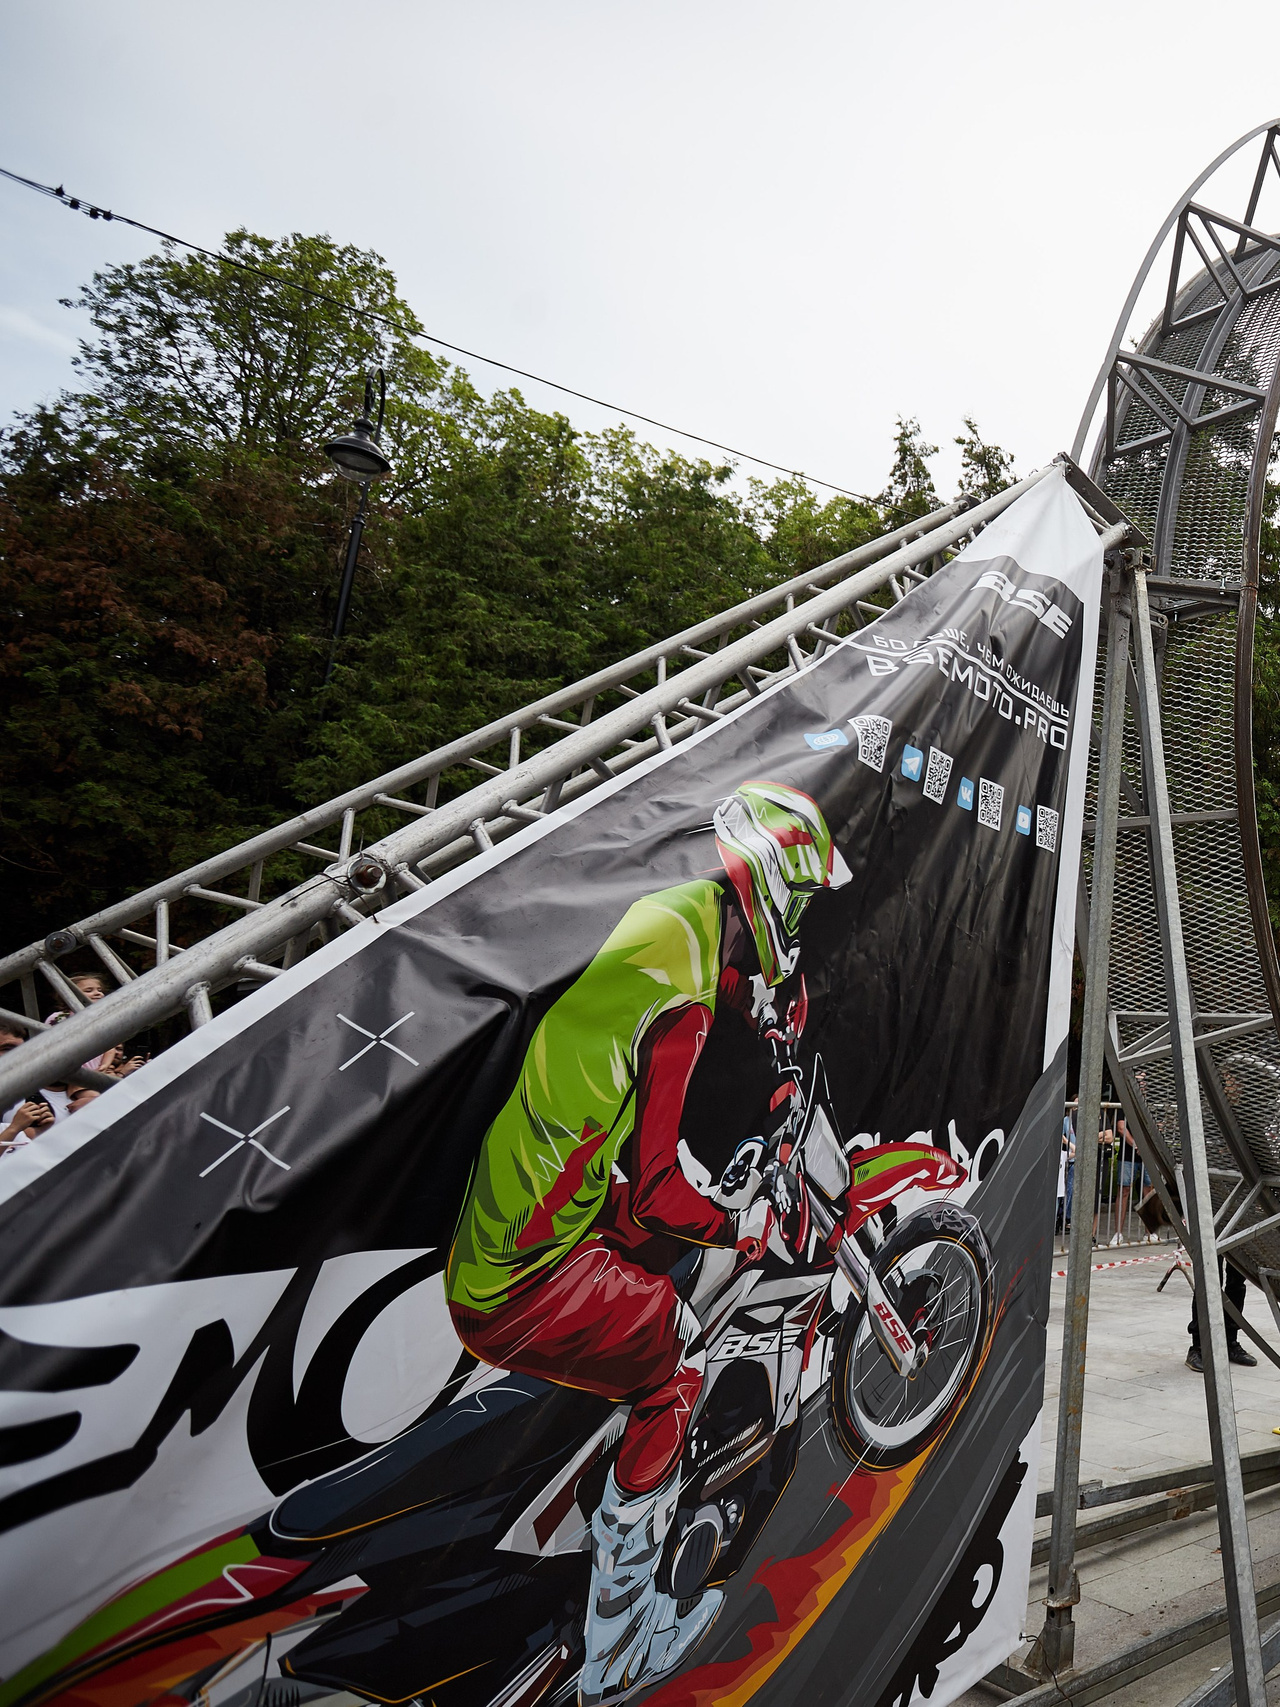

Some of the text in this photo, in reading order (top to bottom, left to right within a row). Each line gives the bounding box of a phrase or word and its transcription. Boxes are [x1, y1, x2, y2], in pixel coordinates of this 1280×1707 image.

[970, 571, 1073, 639] BSE
[977, 643, 1004, 671] ЧЕМ
[1006, 664, 1069, 718] ОЖИДАЕШЬ
[711, 1329, 803, 1361] BSE
[873, 1301, 914, 1354] BSE
